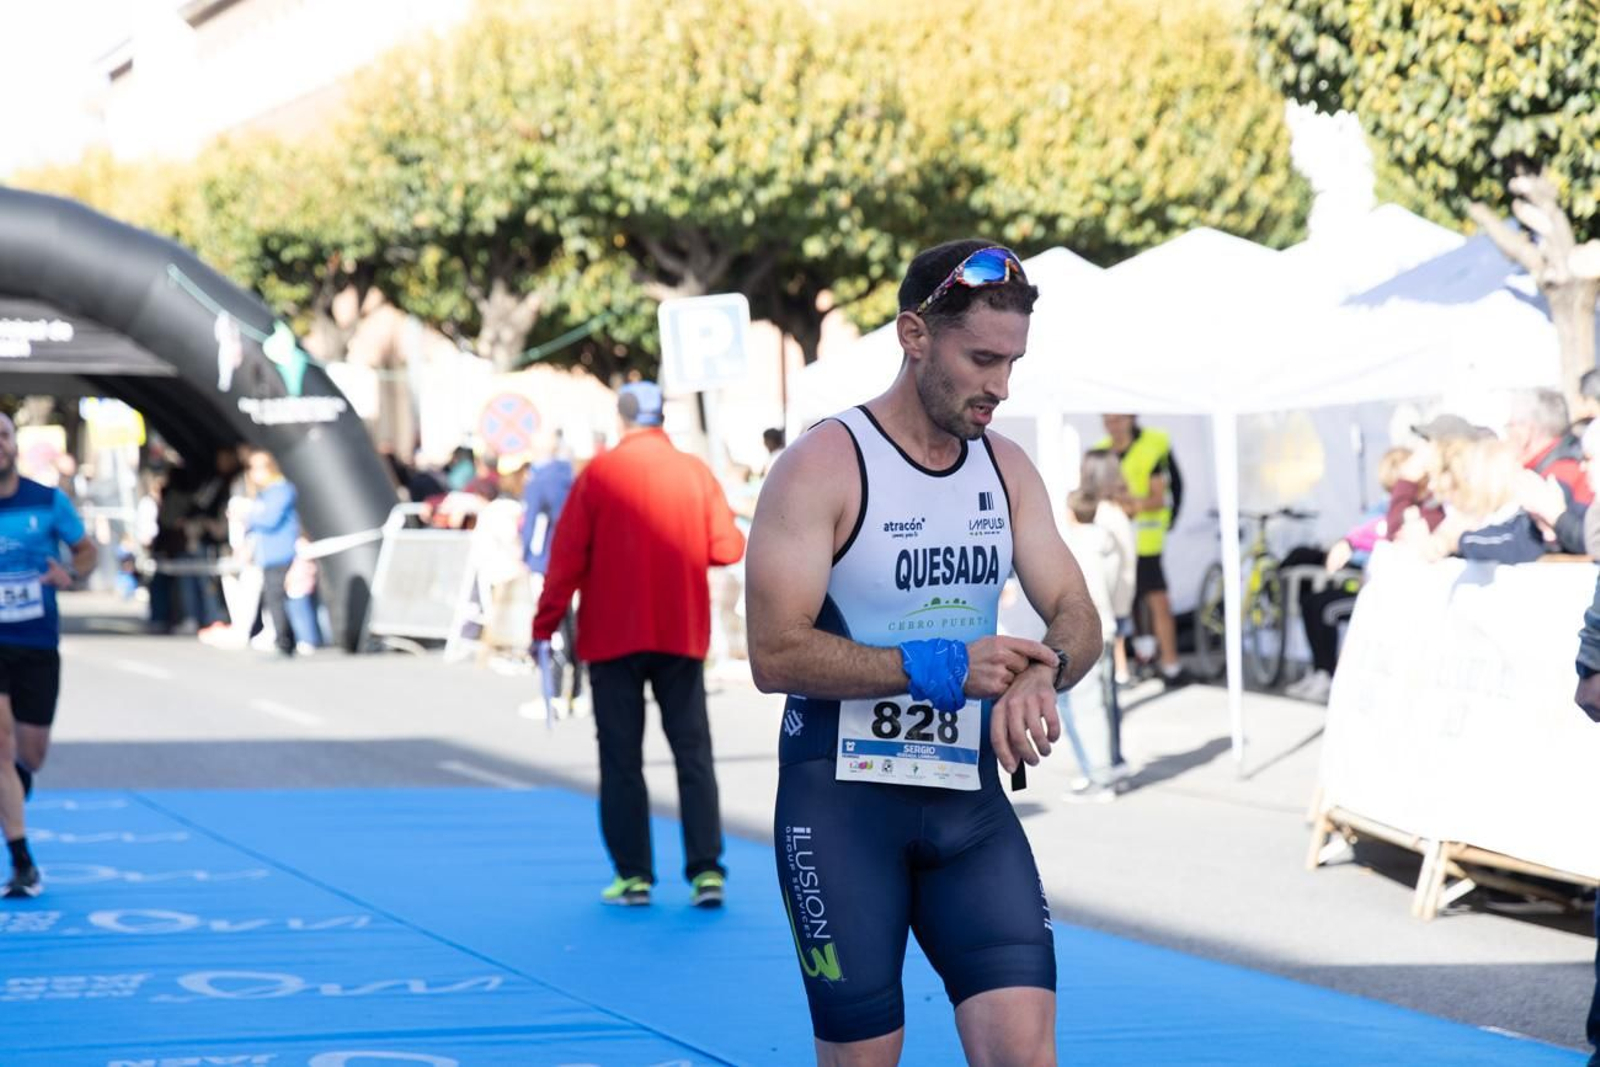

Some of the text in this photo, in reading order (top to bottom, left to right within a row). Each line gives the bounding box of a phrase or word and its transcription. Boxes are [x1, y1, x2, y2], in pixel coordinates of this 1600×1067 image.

[679, 309, 734, 378] P
[883, 517, 923, 532] atracón
[895, 545, 999, 591] QUESADA
[871, 701, 959, 744] 828
[903, 744, 936, 755] SERGIO
[786, 826, 812, 939] GROUP SERVICES
